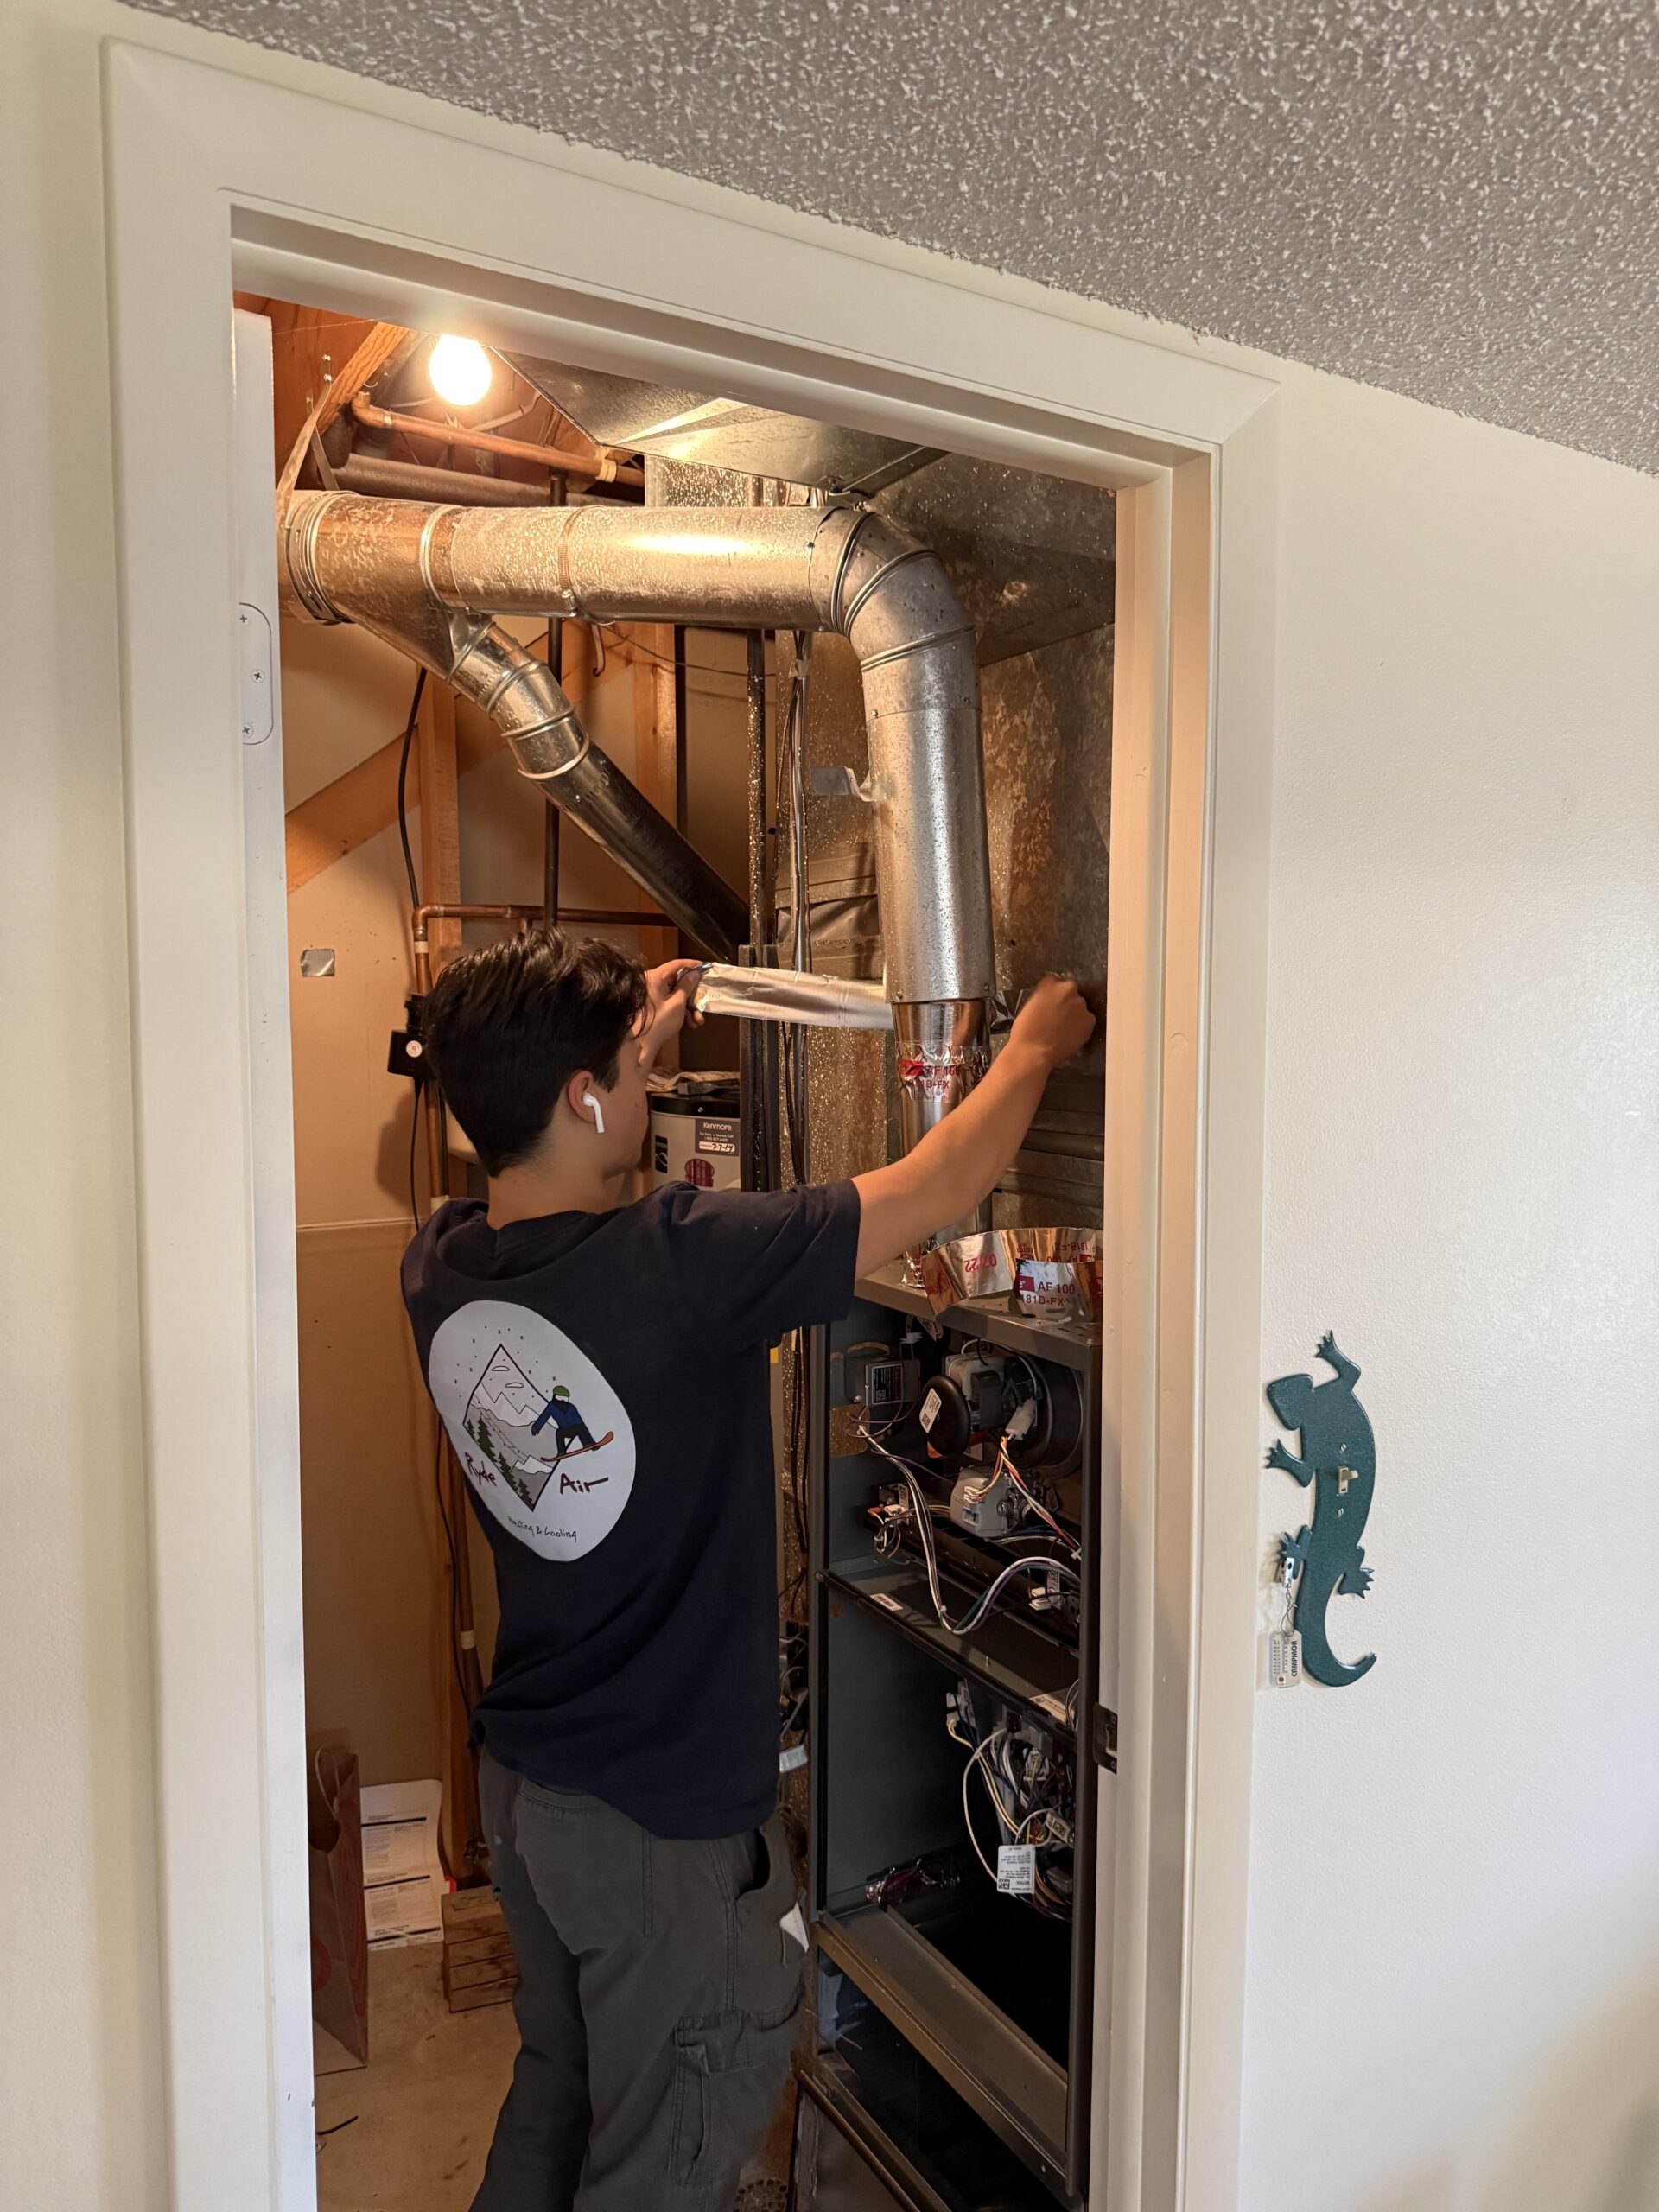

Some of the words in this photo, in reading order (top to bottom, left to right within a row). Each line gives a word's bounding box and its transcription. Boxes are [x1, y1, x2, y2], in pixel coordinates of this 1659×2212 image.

[703, 1122, 732, 1131] Kenmore
[1038, 1281, 1052, 1292] AF
[1056, 1283, 1075, 1294] 100
[559, 1472, 609, 1495] Air
[544, 1526, 577, 1543] Cooling
